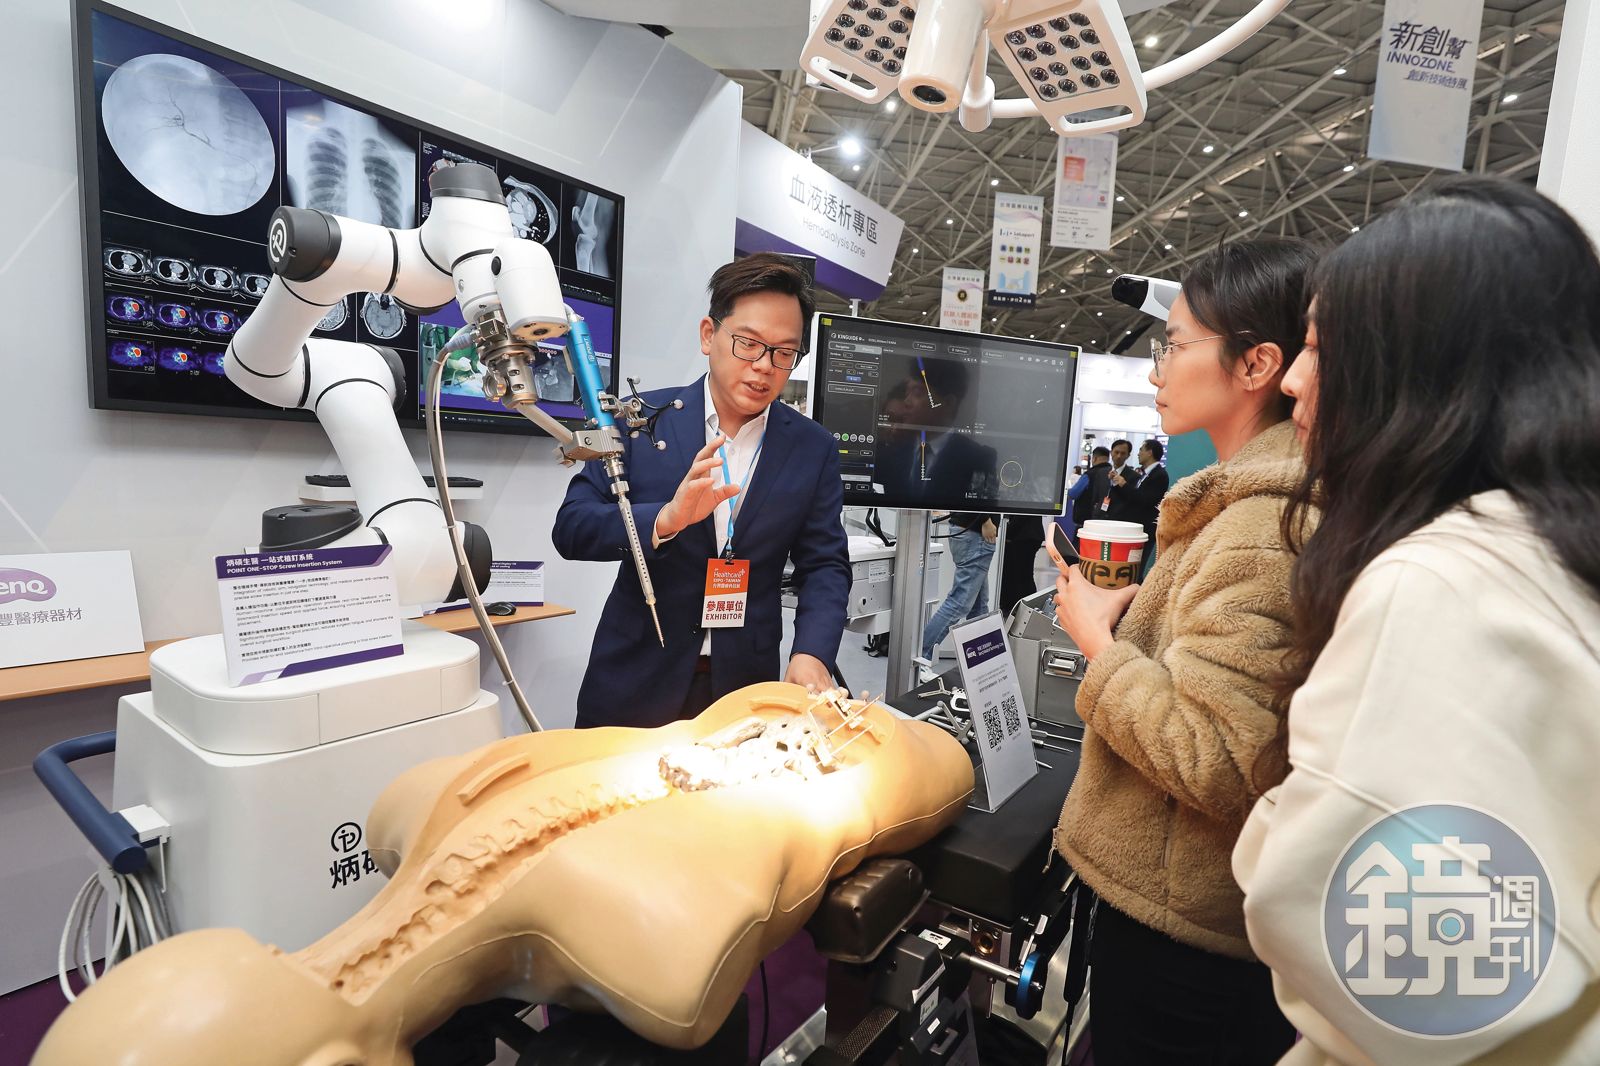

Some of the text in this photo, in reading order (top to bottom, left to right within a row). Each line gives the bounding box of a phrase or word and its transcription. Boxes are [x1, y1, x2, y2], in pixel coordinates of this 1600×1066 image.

[1387, 51, 1455, 73] INNOZONE
[790, 174, 878, 244] 血液透析專區
[802, 217, 866, 258] Hemodialysis Zone
[226, 553, 314, 566] 炳碩生醫 一站式植釘系統
[0, 580, 48, 595] enQ
[706, 601, 743, 612] 參展單位
